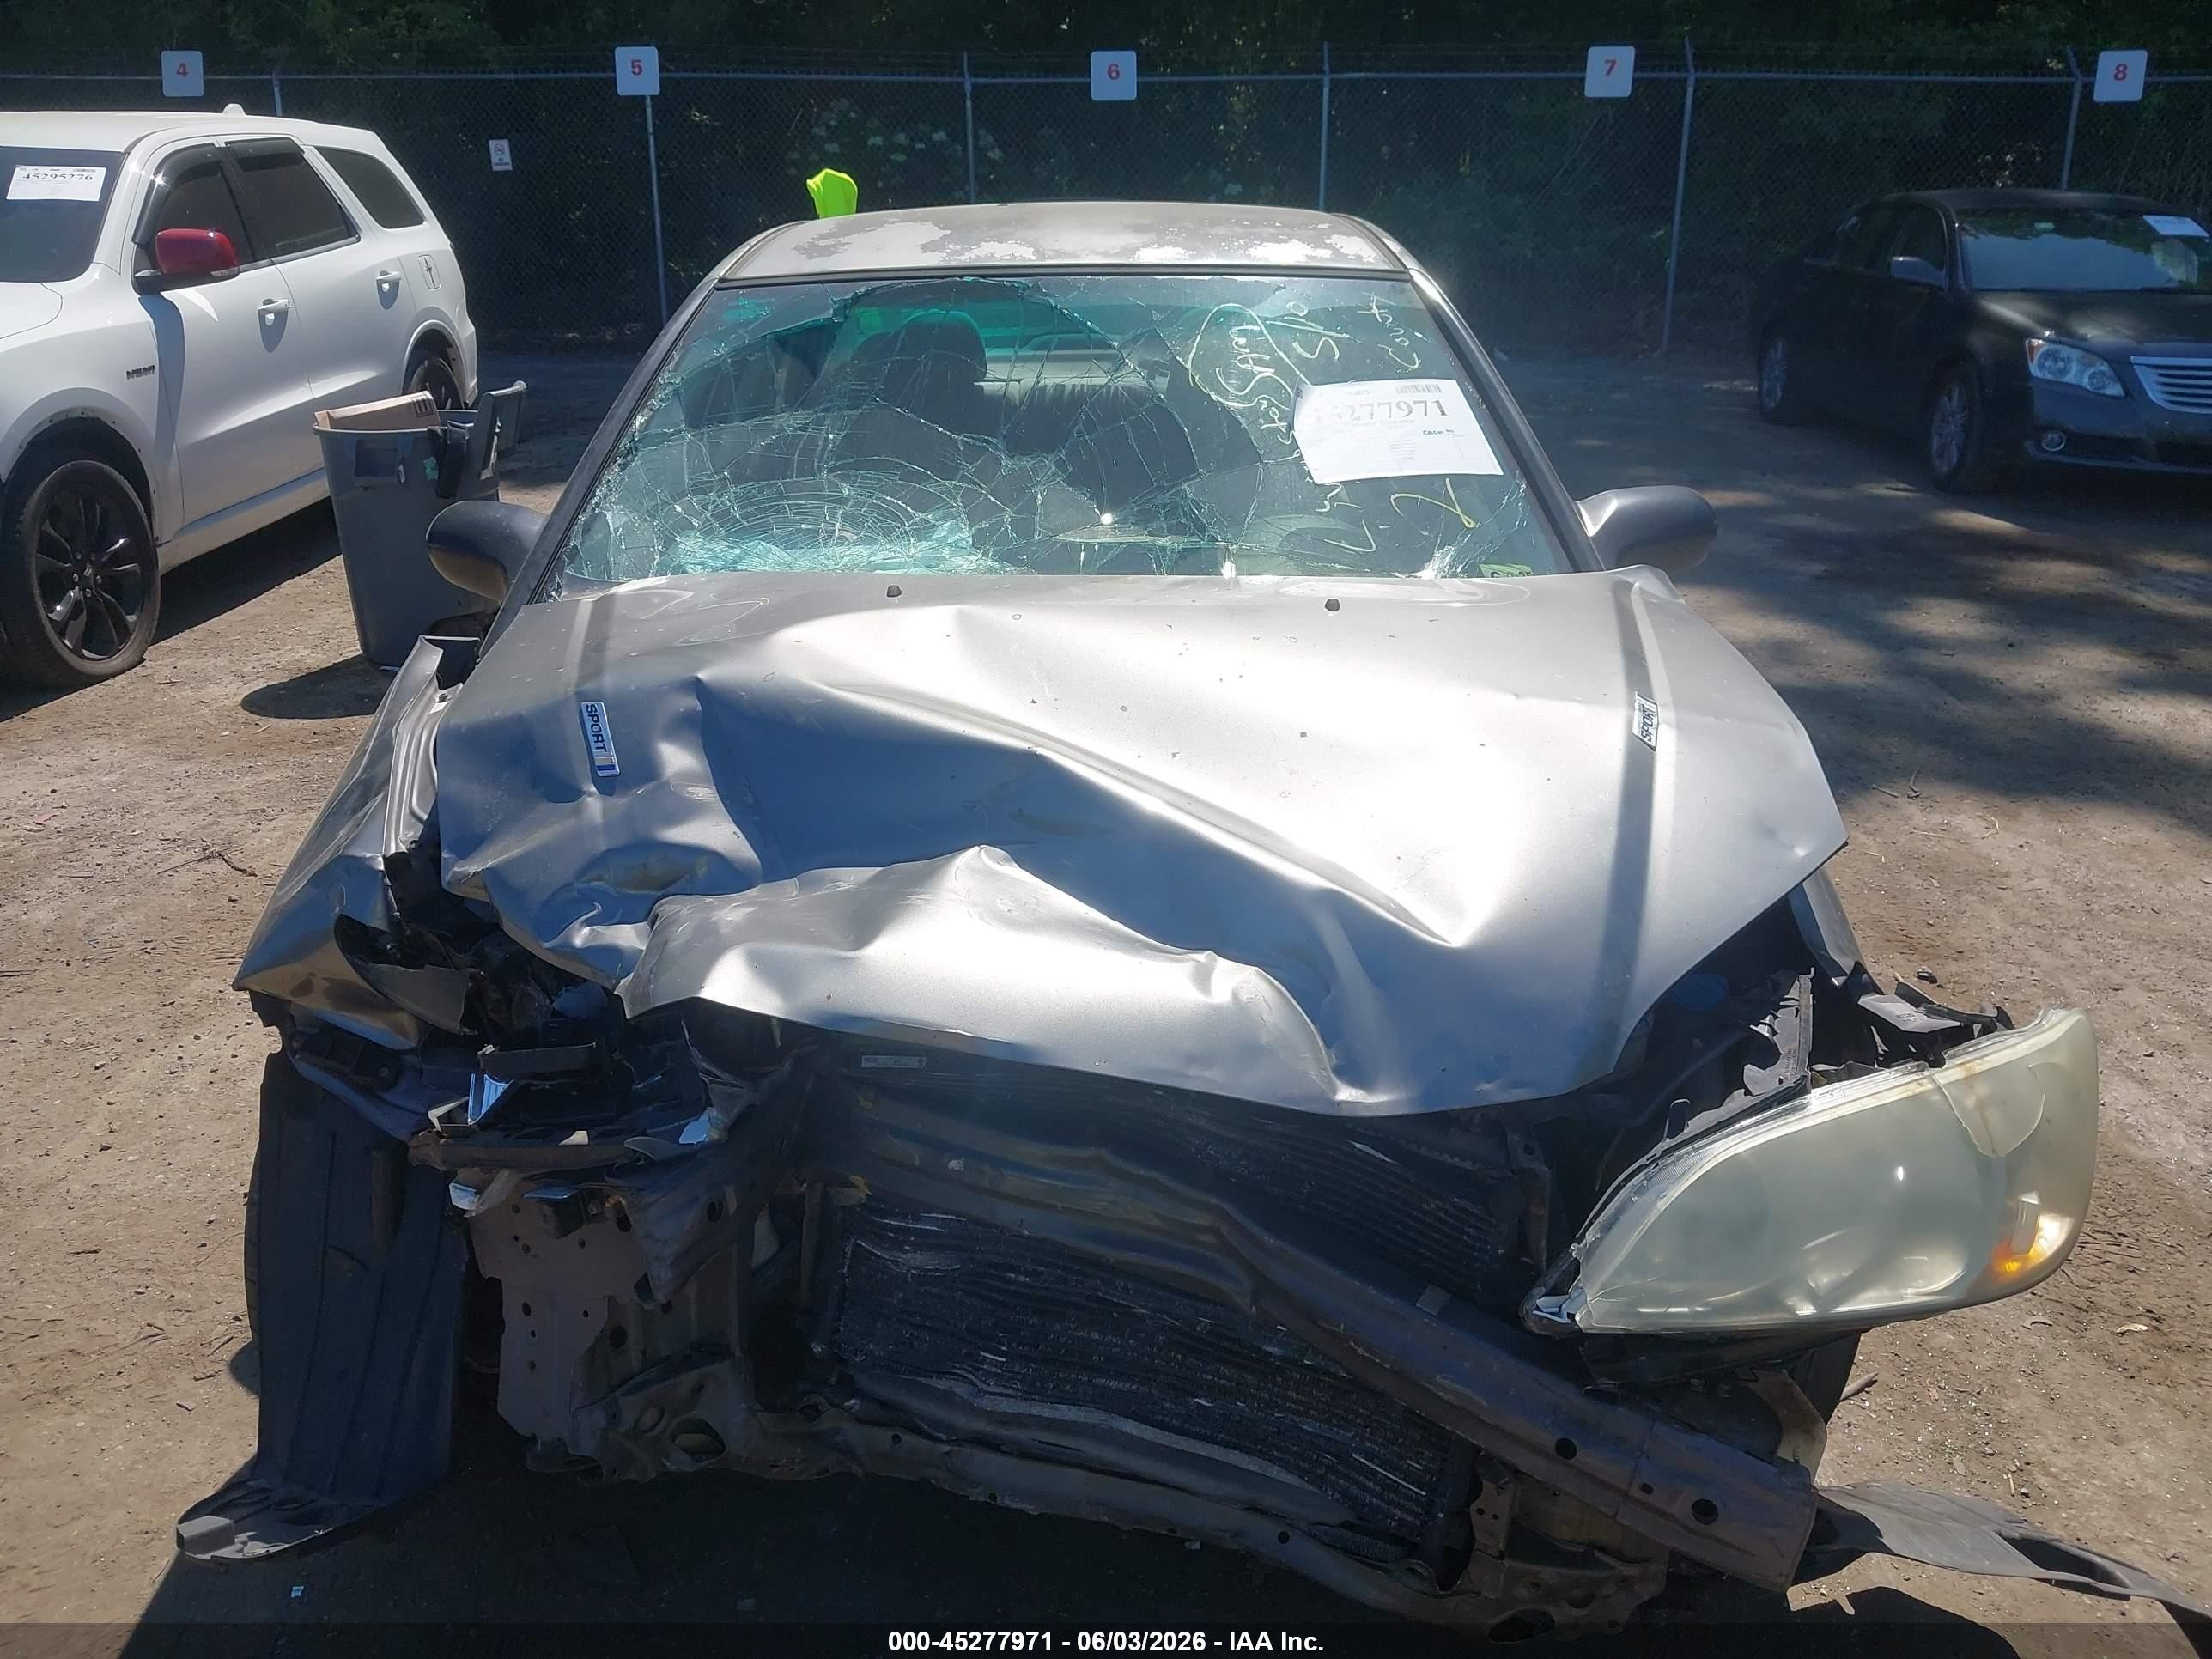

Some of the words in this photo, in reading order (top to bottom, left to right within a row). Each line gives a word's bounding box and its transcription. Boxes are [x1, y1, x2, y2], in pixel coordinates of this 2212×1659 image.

[176, 62, 189, 77] 4
[631, 59, 643, 76] 5
[1108, 64, 1120, 80] 6
[1604, 59, 1617, 76] 7
[2113, 64, 2128, 81] 8
[21, 173, 93, 181] 45295276
[586, 704, 607, 752] SPORT
[1640, 703, 1656, 742] SPORT
